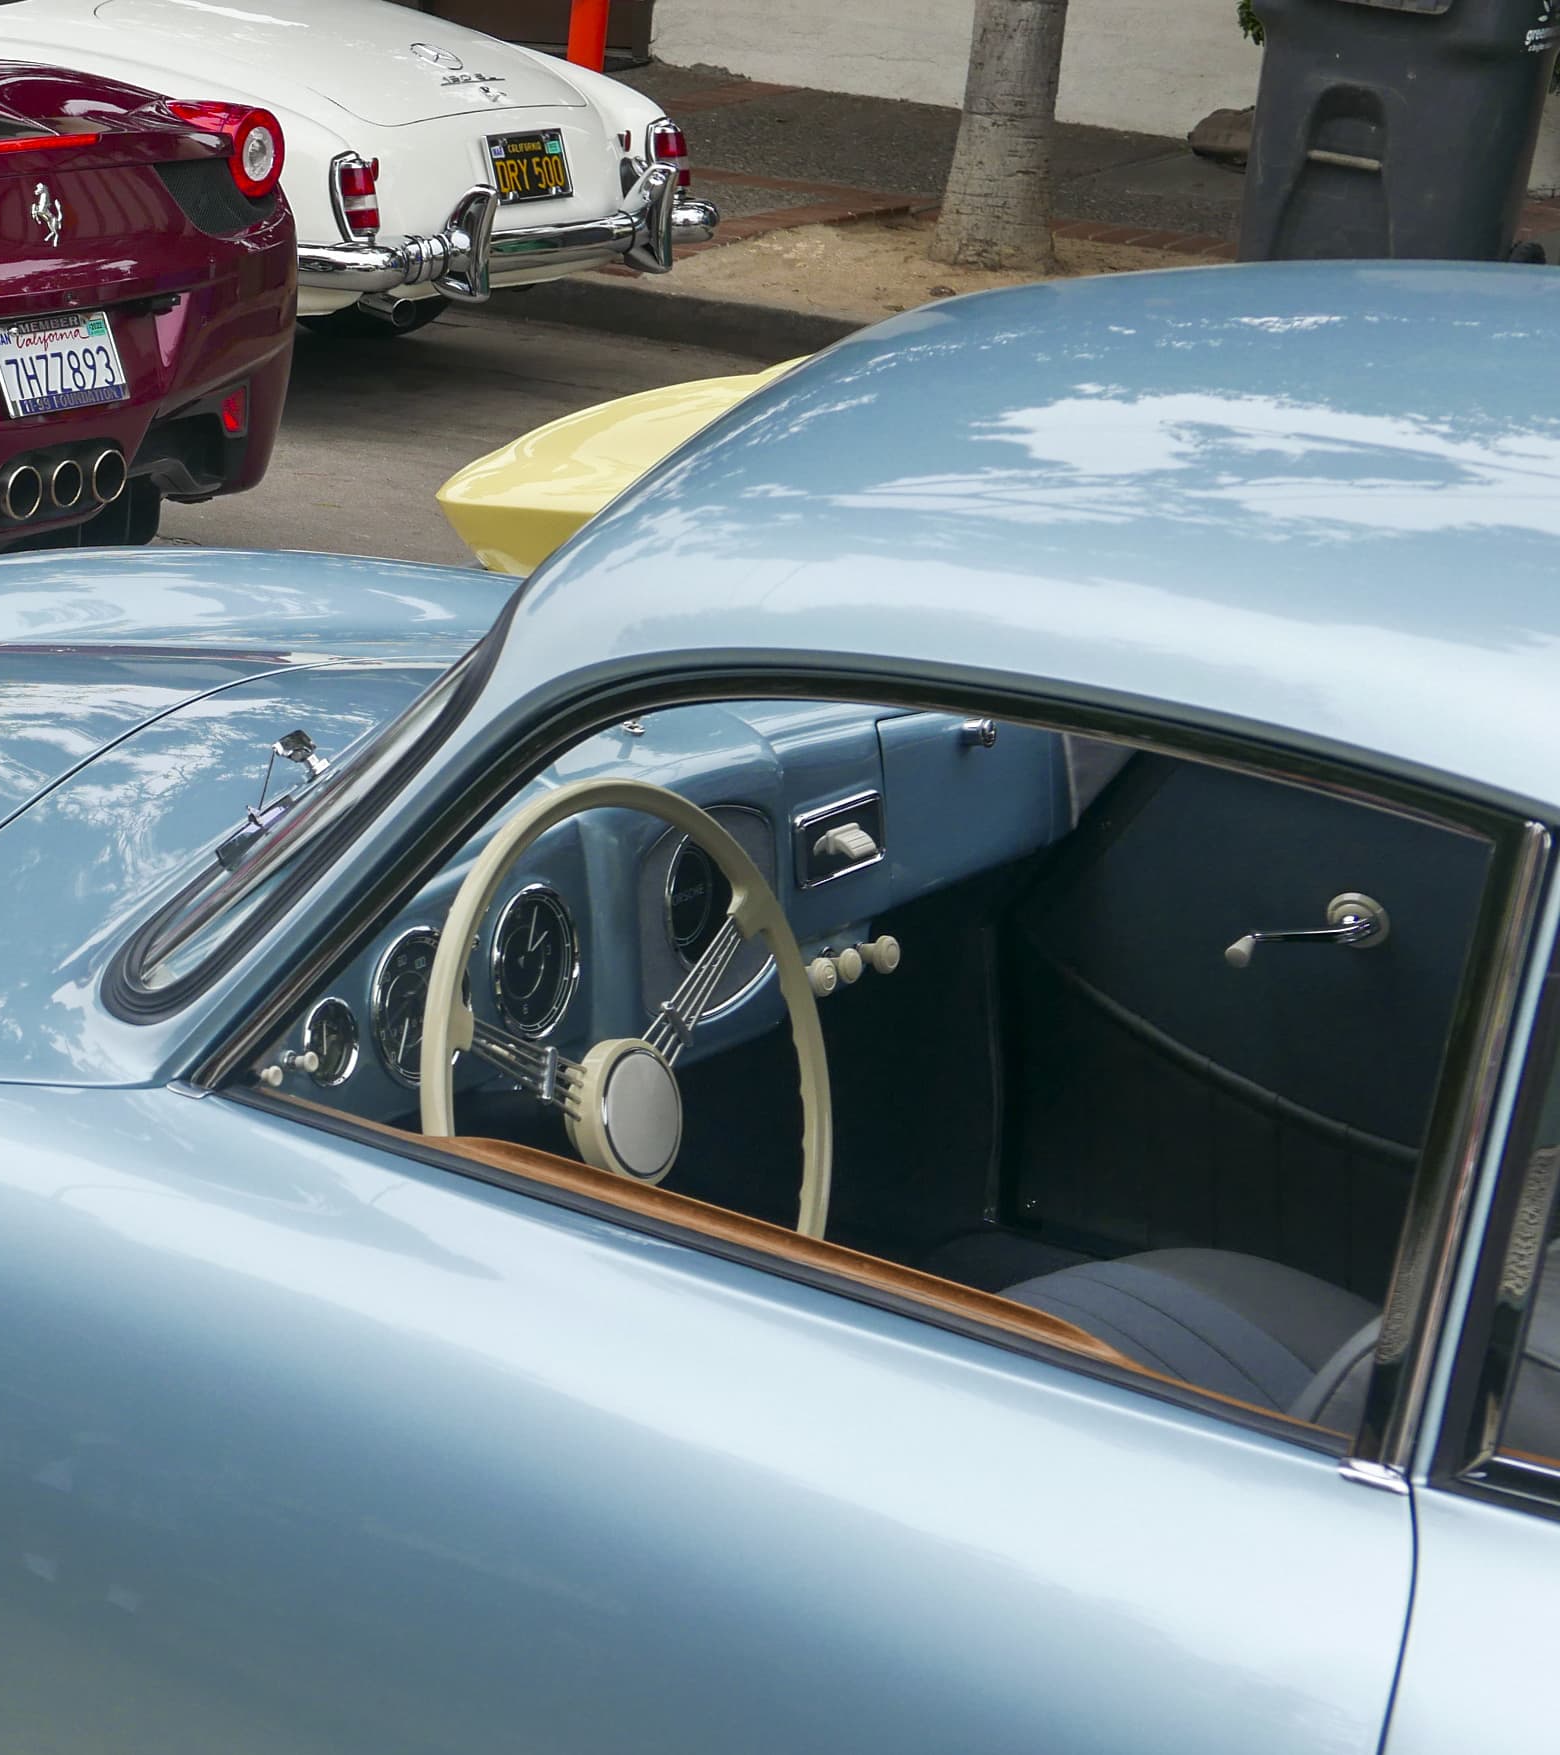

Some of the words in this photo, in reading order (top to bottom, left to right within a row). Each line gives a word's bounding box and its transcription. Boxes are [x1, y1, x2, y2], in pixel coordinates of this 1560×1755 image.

[495, 158, 531, 193] DRY
[532, 155, 565, 190] 500
[16, 327, 90, 352] California
[18, 315, 80, 334] MEMBER
[5, 345, 116, 400] 7HZZ893
